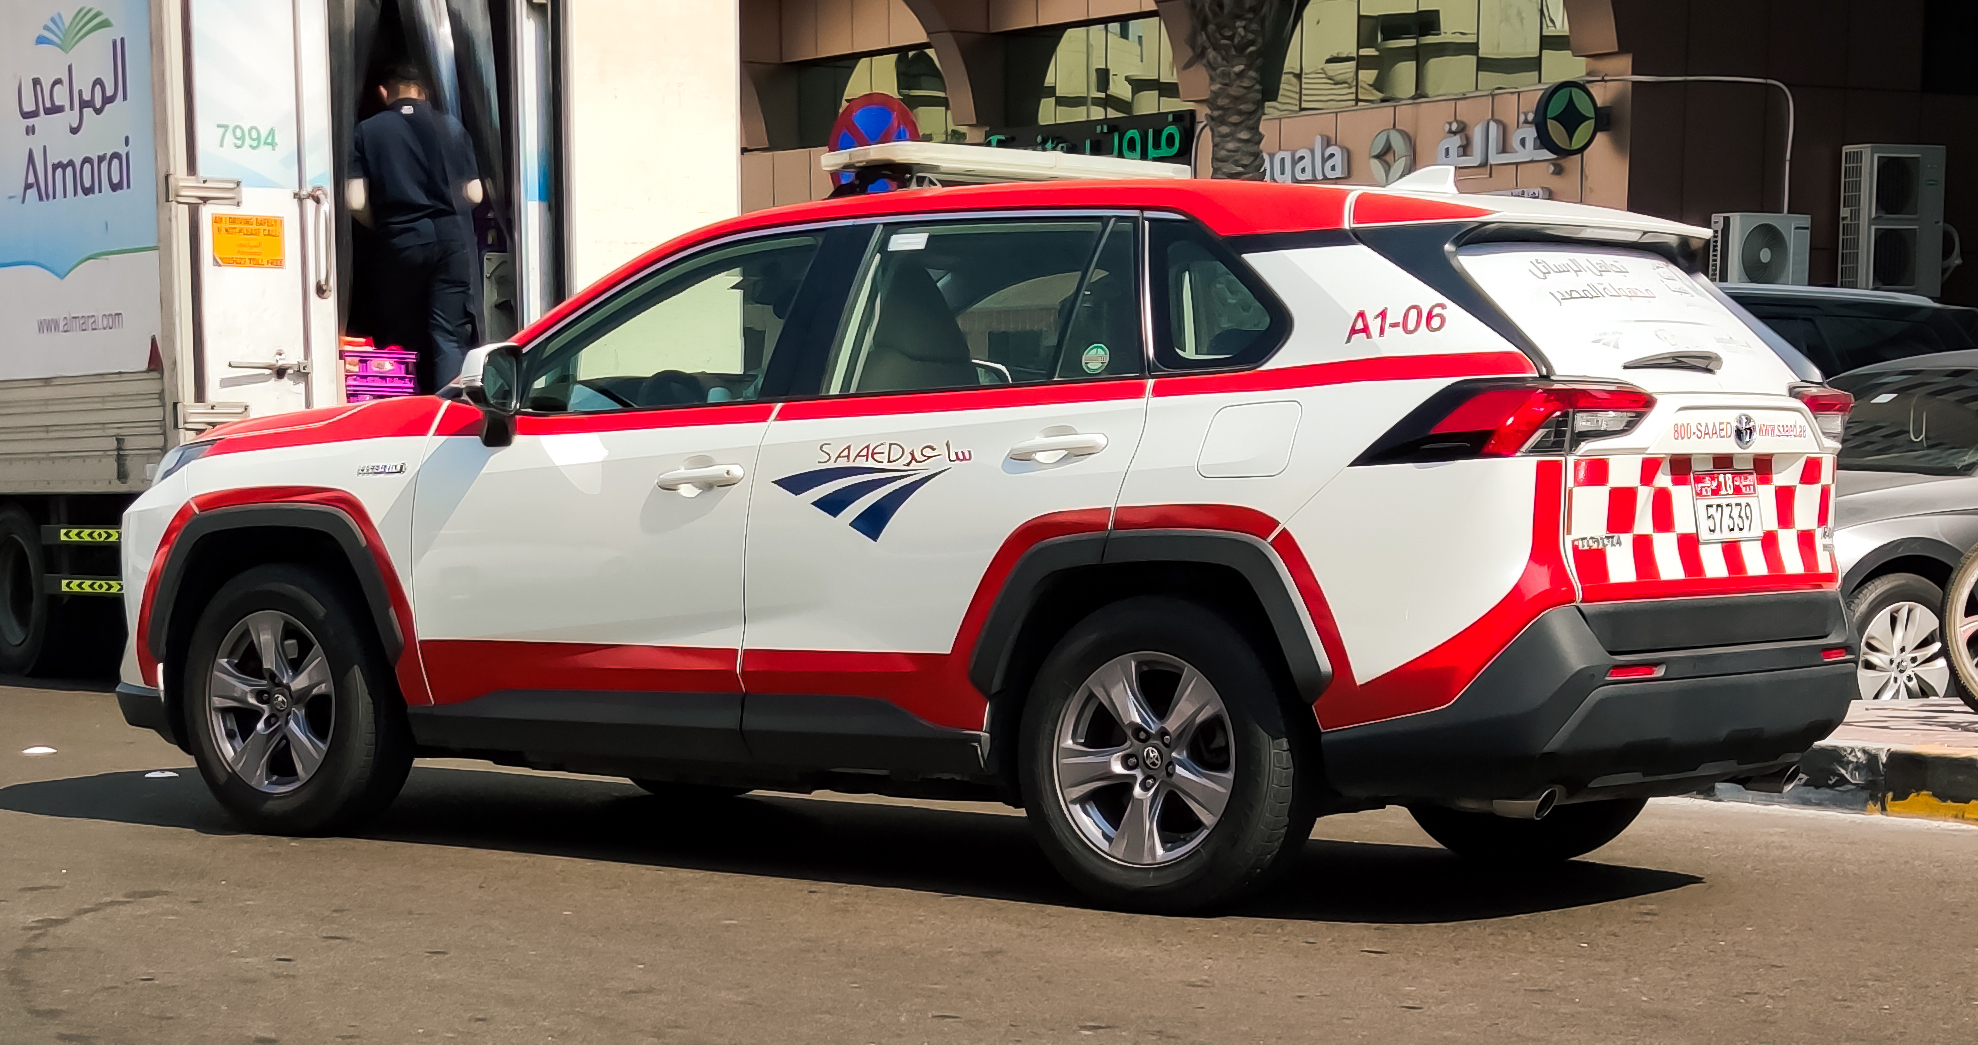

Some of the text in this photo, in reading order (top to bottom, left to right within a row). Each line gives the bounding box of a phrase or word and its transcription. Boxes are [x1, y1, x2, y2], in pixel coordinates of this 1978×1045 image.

[17, 36, 128, 136] المراعي
[216, 123, 278, 151] 7994
[1437, 110, 1563, 175] قالة
[21, 135, 131, 204] Almarai
[1549, 283, 1602, 306] المصدر
[37, 311, 124, 334] www.almarai.com
[1345, 303, 1448, 345] A1-06
[1673, 421, 1733, 440] 800-SAAED
[817, 442, 905, 464] SAAED
[902, 439, 972, 467] ساعد
[1718, 473, 1734, 495] 18
[1705, 502, 1753, 535] 57339
